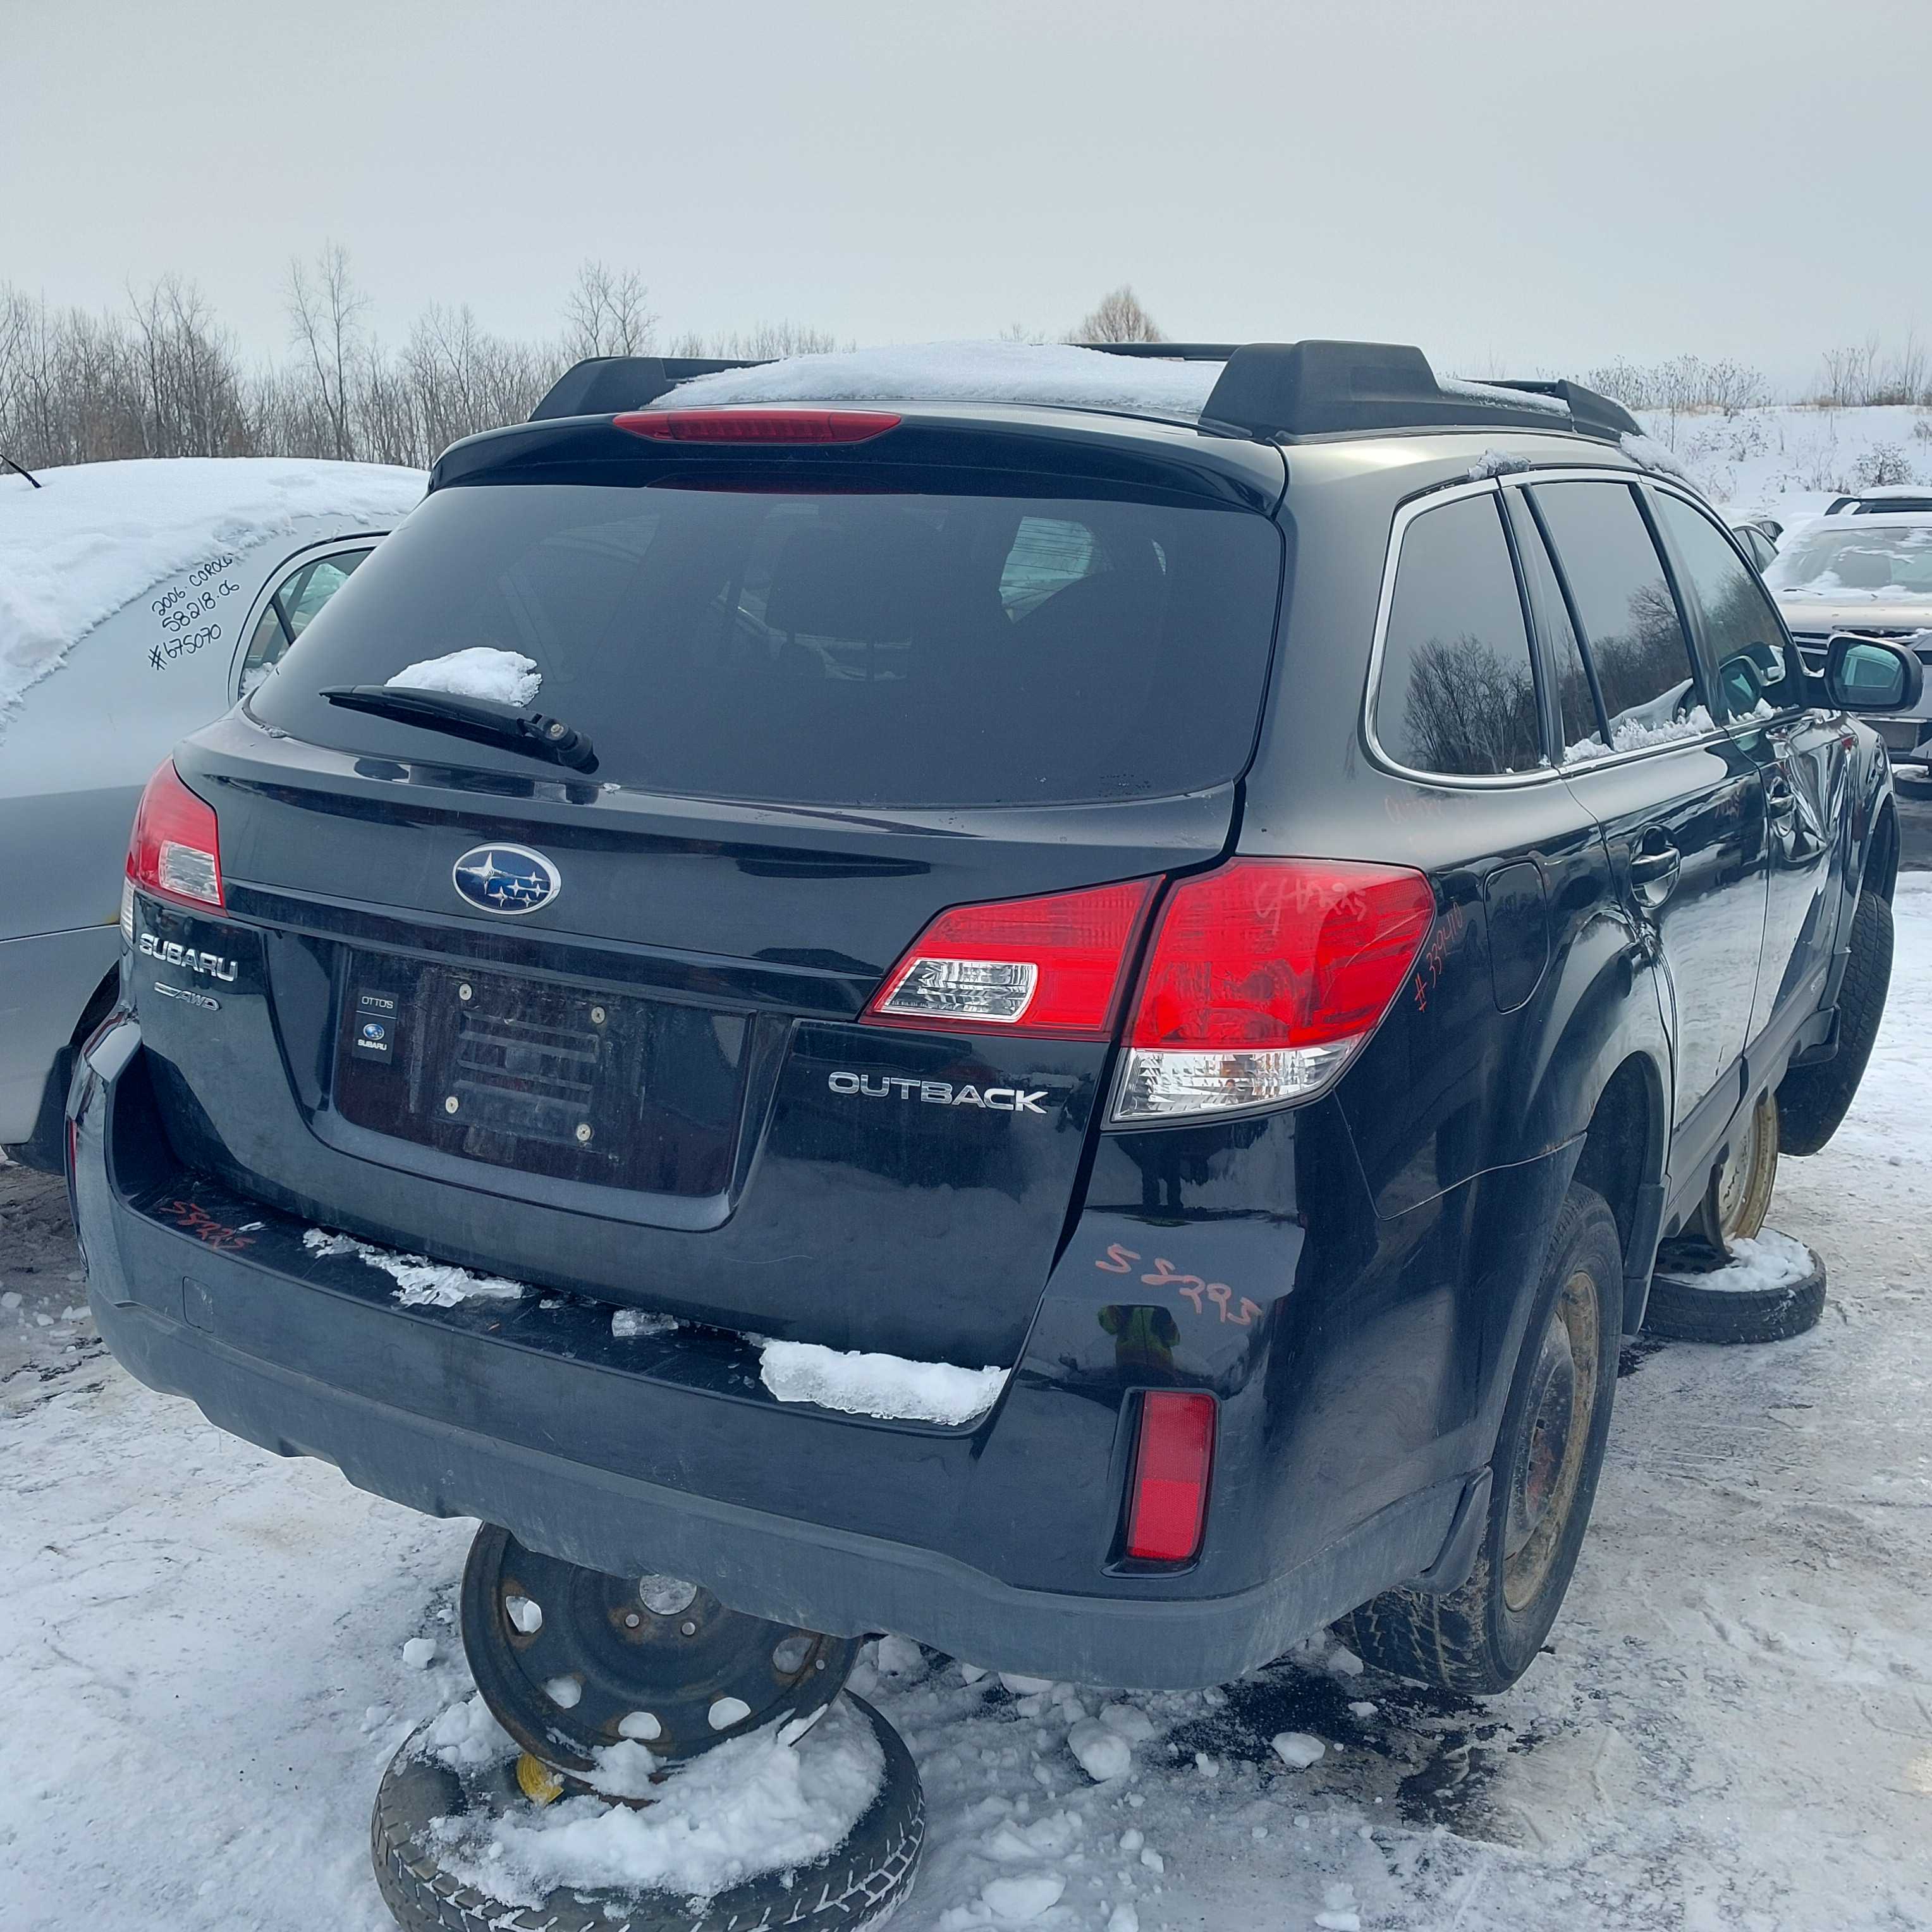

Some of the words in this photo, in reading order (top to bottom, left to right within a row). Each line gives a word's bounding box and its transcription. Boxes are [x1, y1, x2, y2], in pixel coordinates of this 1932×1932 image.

[148, 624, 221, 670] #675070
[140, 933, 238, 982] SUBARU
[358, 1039, 387, 1051] SUBARU
[828, 1072, 1048, 1114] OUTBACK
